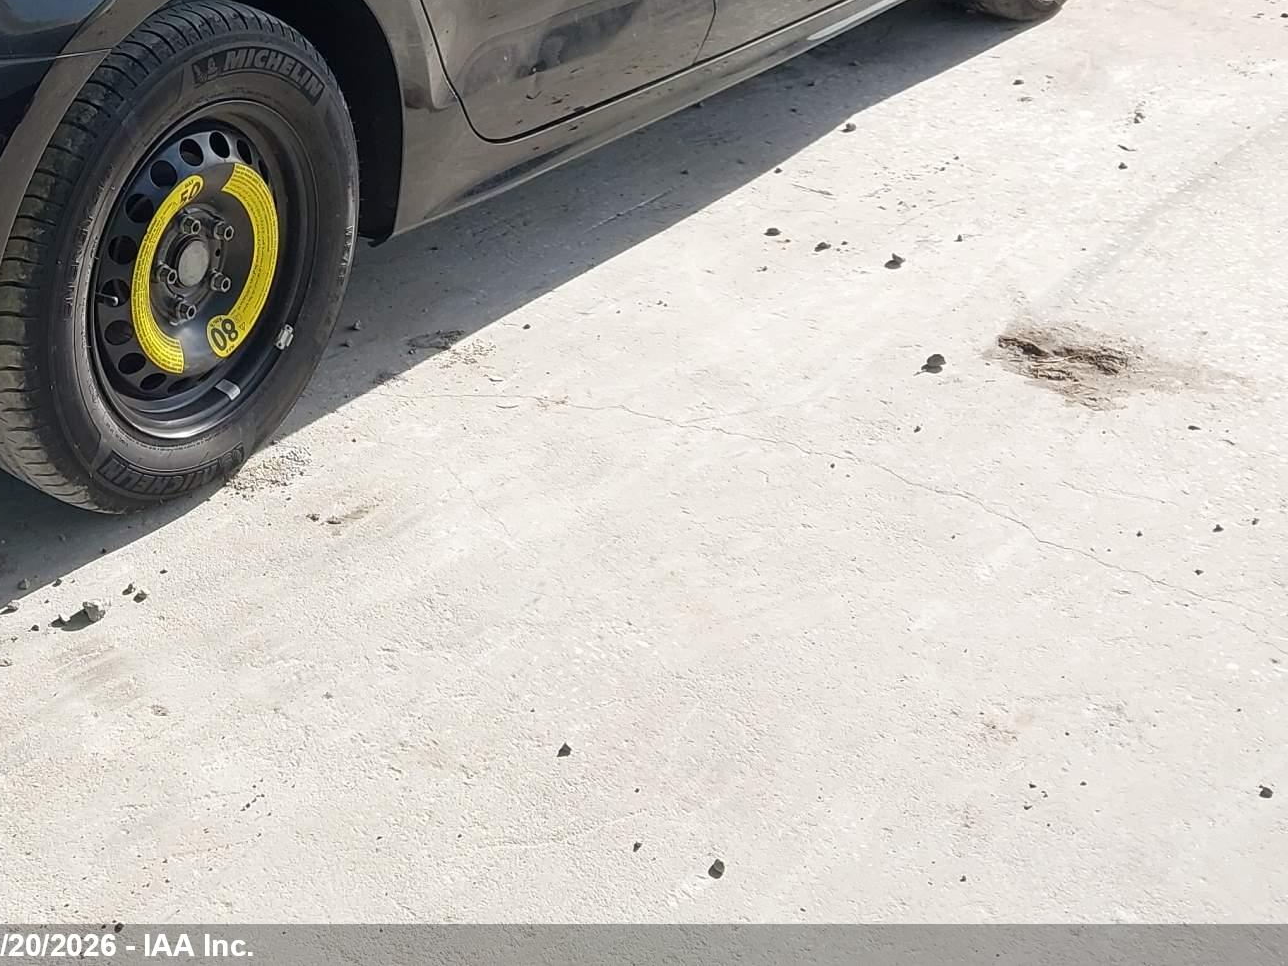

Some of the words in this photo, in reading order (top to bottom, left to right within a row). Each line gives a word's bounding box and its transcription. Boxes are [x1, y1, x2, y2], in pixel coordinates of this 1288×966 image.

[223, 47, 325, 98] MICHELIN
[180, 181, 201, 206] 50
[211, 319, 238, 351] 80
[98, 457, 219, 495] MICHELIN
